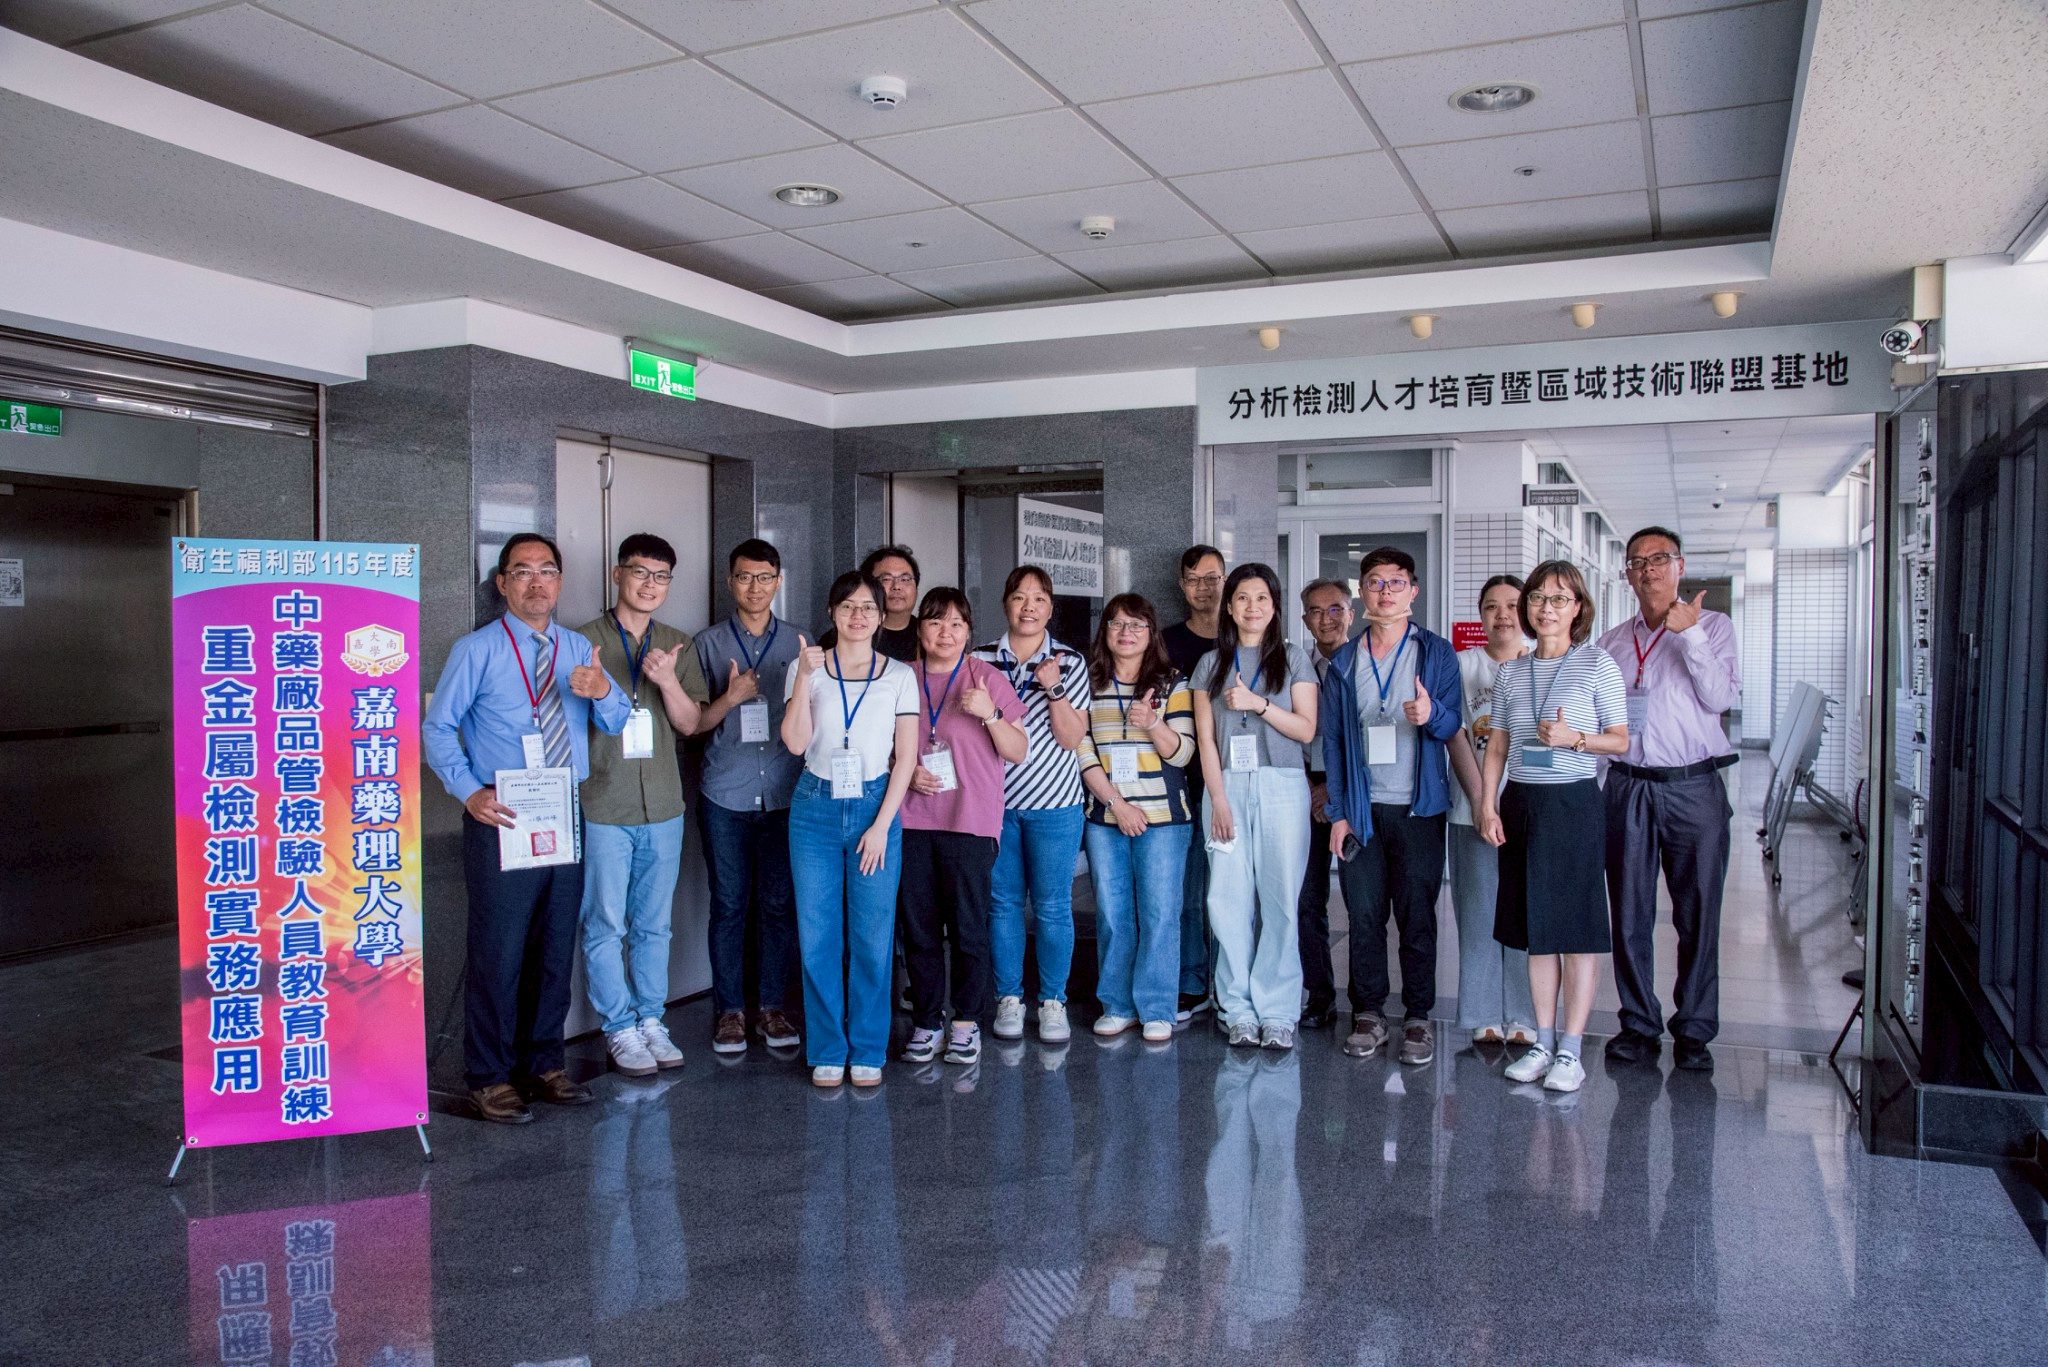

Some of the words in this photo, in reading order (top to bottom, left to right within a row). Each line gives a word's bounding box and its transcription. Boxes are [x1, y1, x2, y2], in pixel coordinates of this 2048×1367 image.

[634, 373, 656, 387] EXIT
[1228, 350, 1849, 420] 分析檢測人才培育暨區域技術聯盟基地
[181, 547, 414, 578] 衛生福利部115年度
[202, 625, 263, 1094] 重金屬檢測實務應用
[273, 590, 333, 1125] 中藥廠品管檢驗人員教育訓練
[351, 685, 404, 967] 嘉南藥理大學
